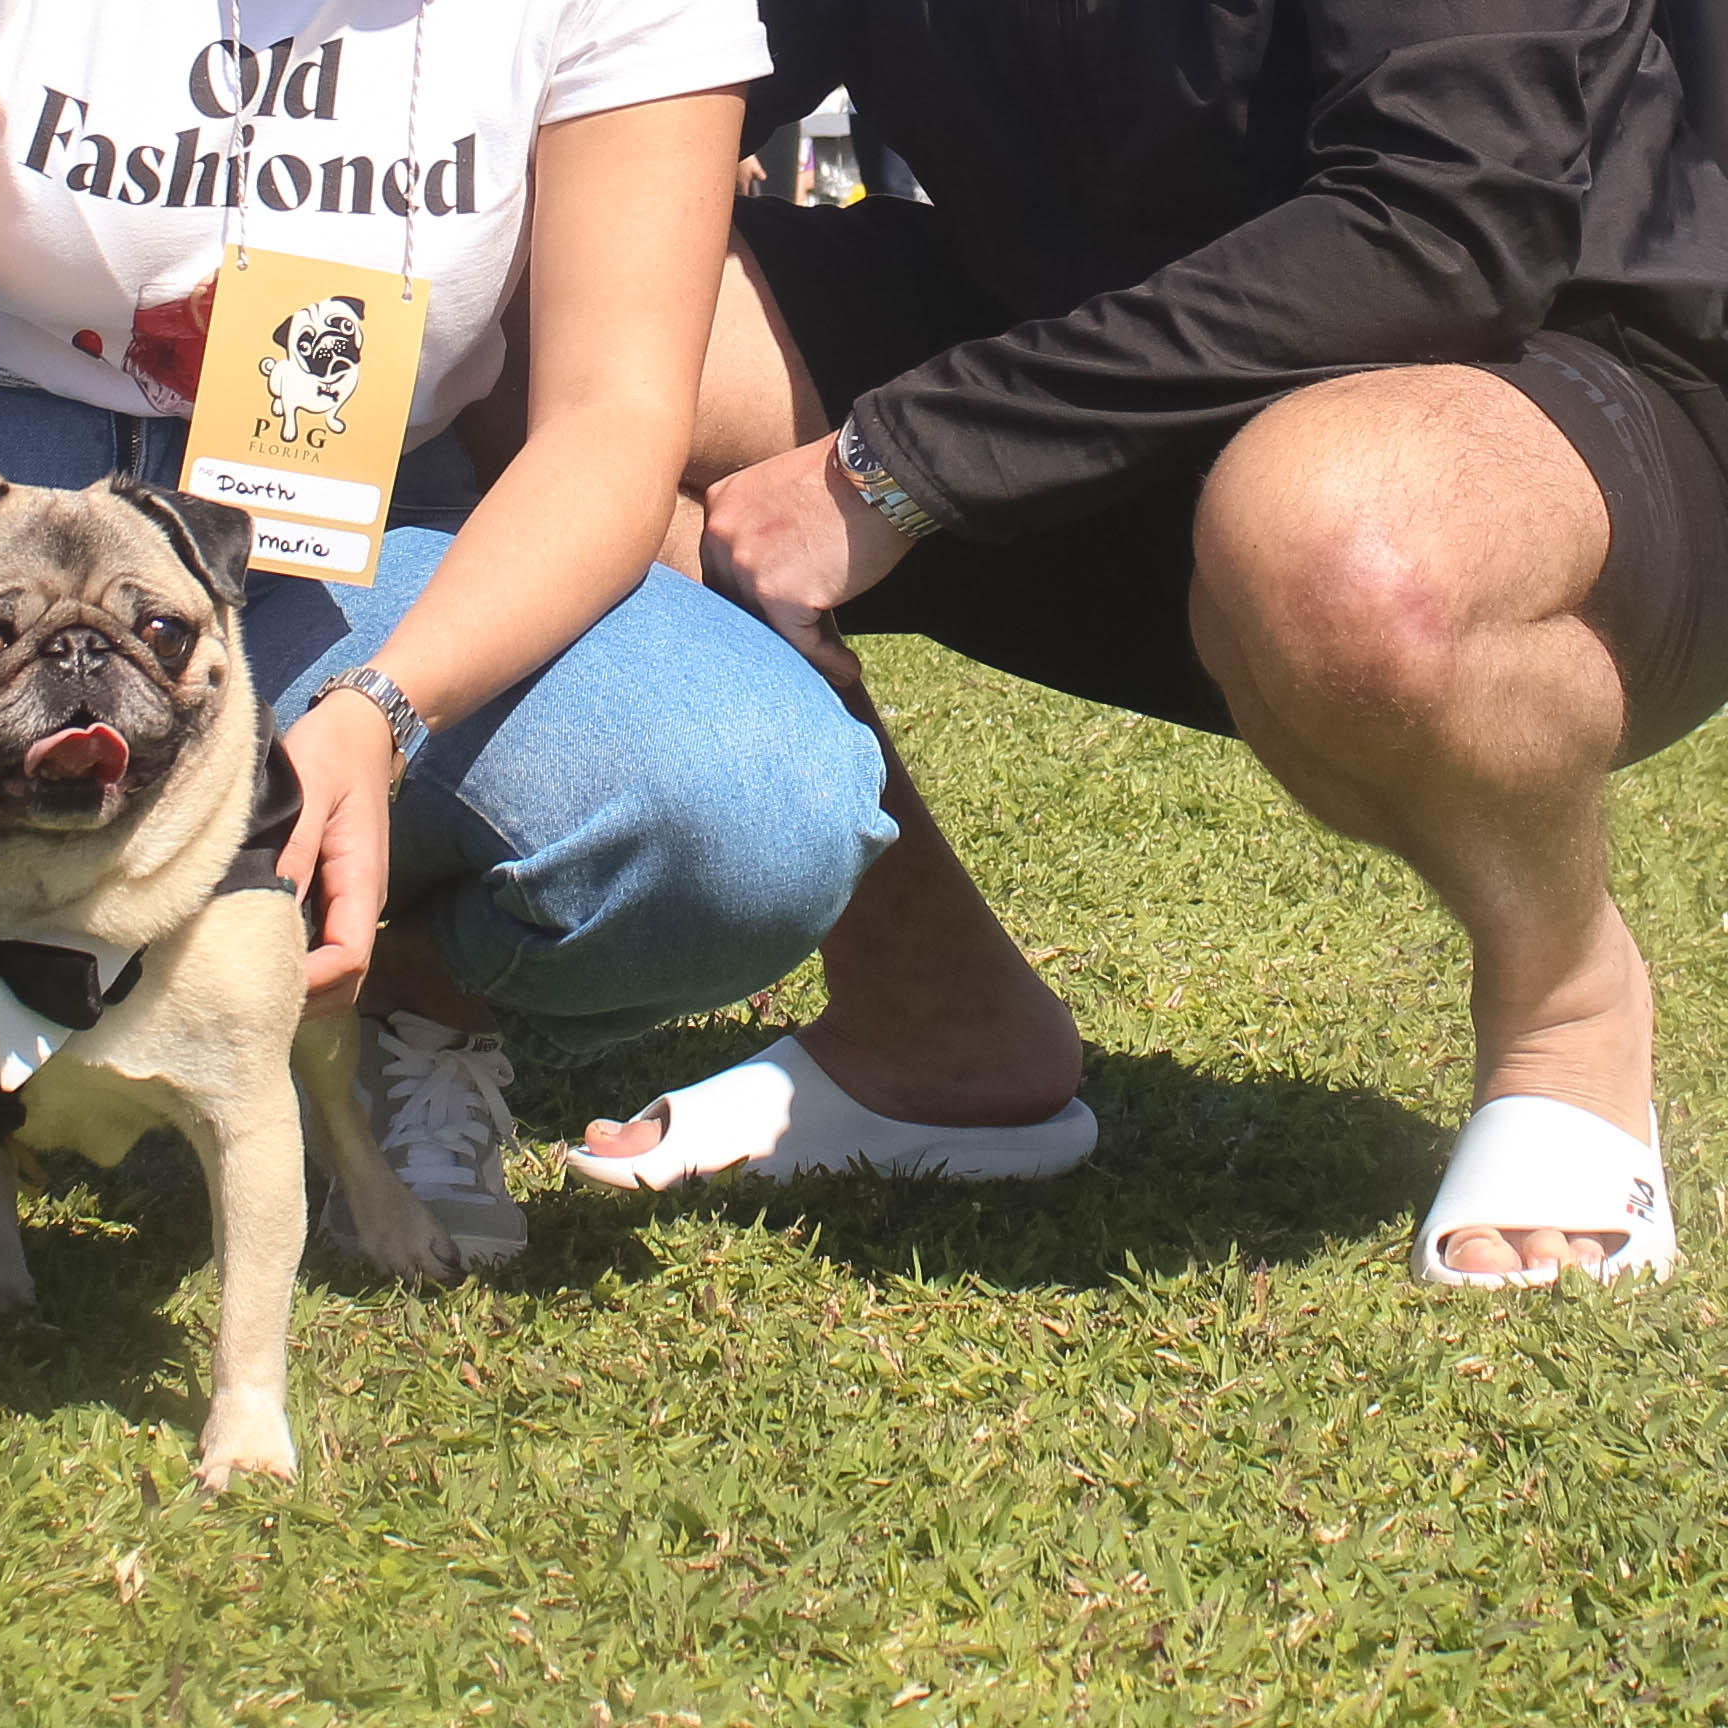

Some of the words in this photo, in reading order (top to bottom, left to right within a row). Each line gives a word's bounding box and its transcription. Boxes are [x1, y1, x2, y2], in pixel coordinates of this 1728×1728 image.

[188, 36, 345, 121] Old
[18, 84, 480, 218] Fashioned
[248, 440, 321, 463] FLORIPA
[217, 474, 296, 501] Darth
[1626, 1176, 1654, 1224] FILA
